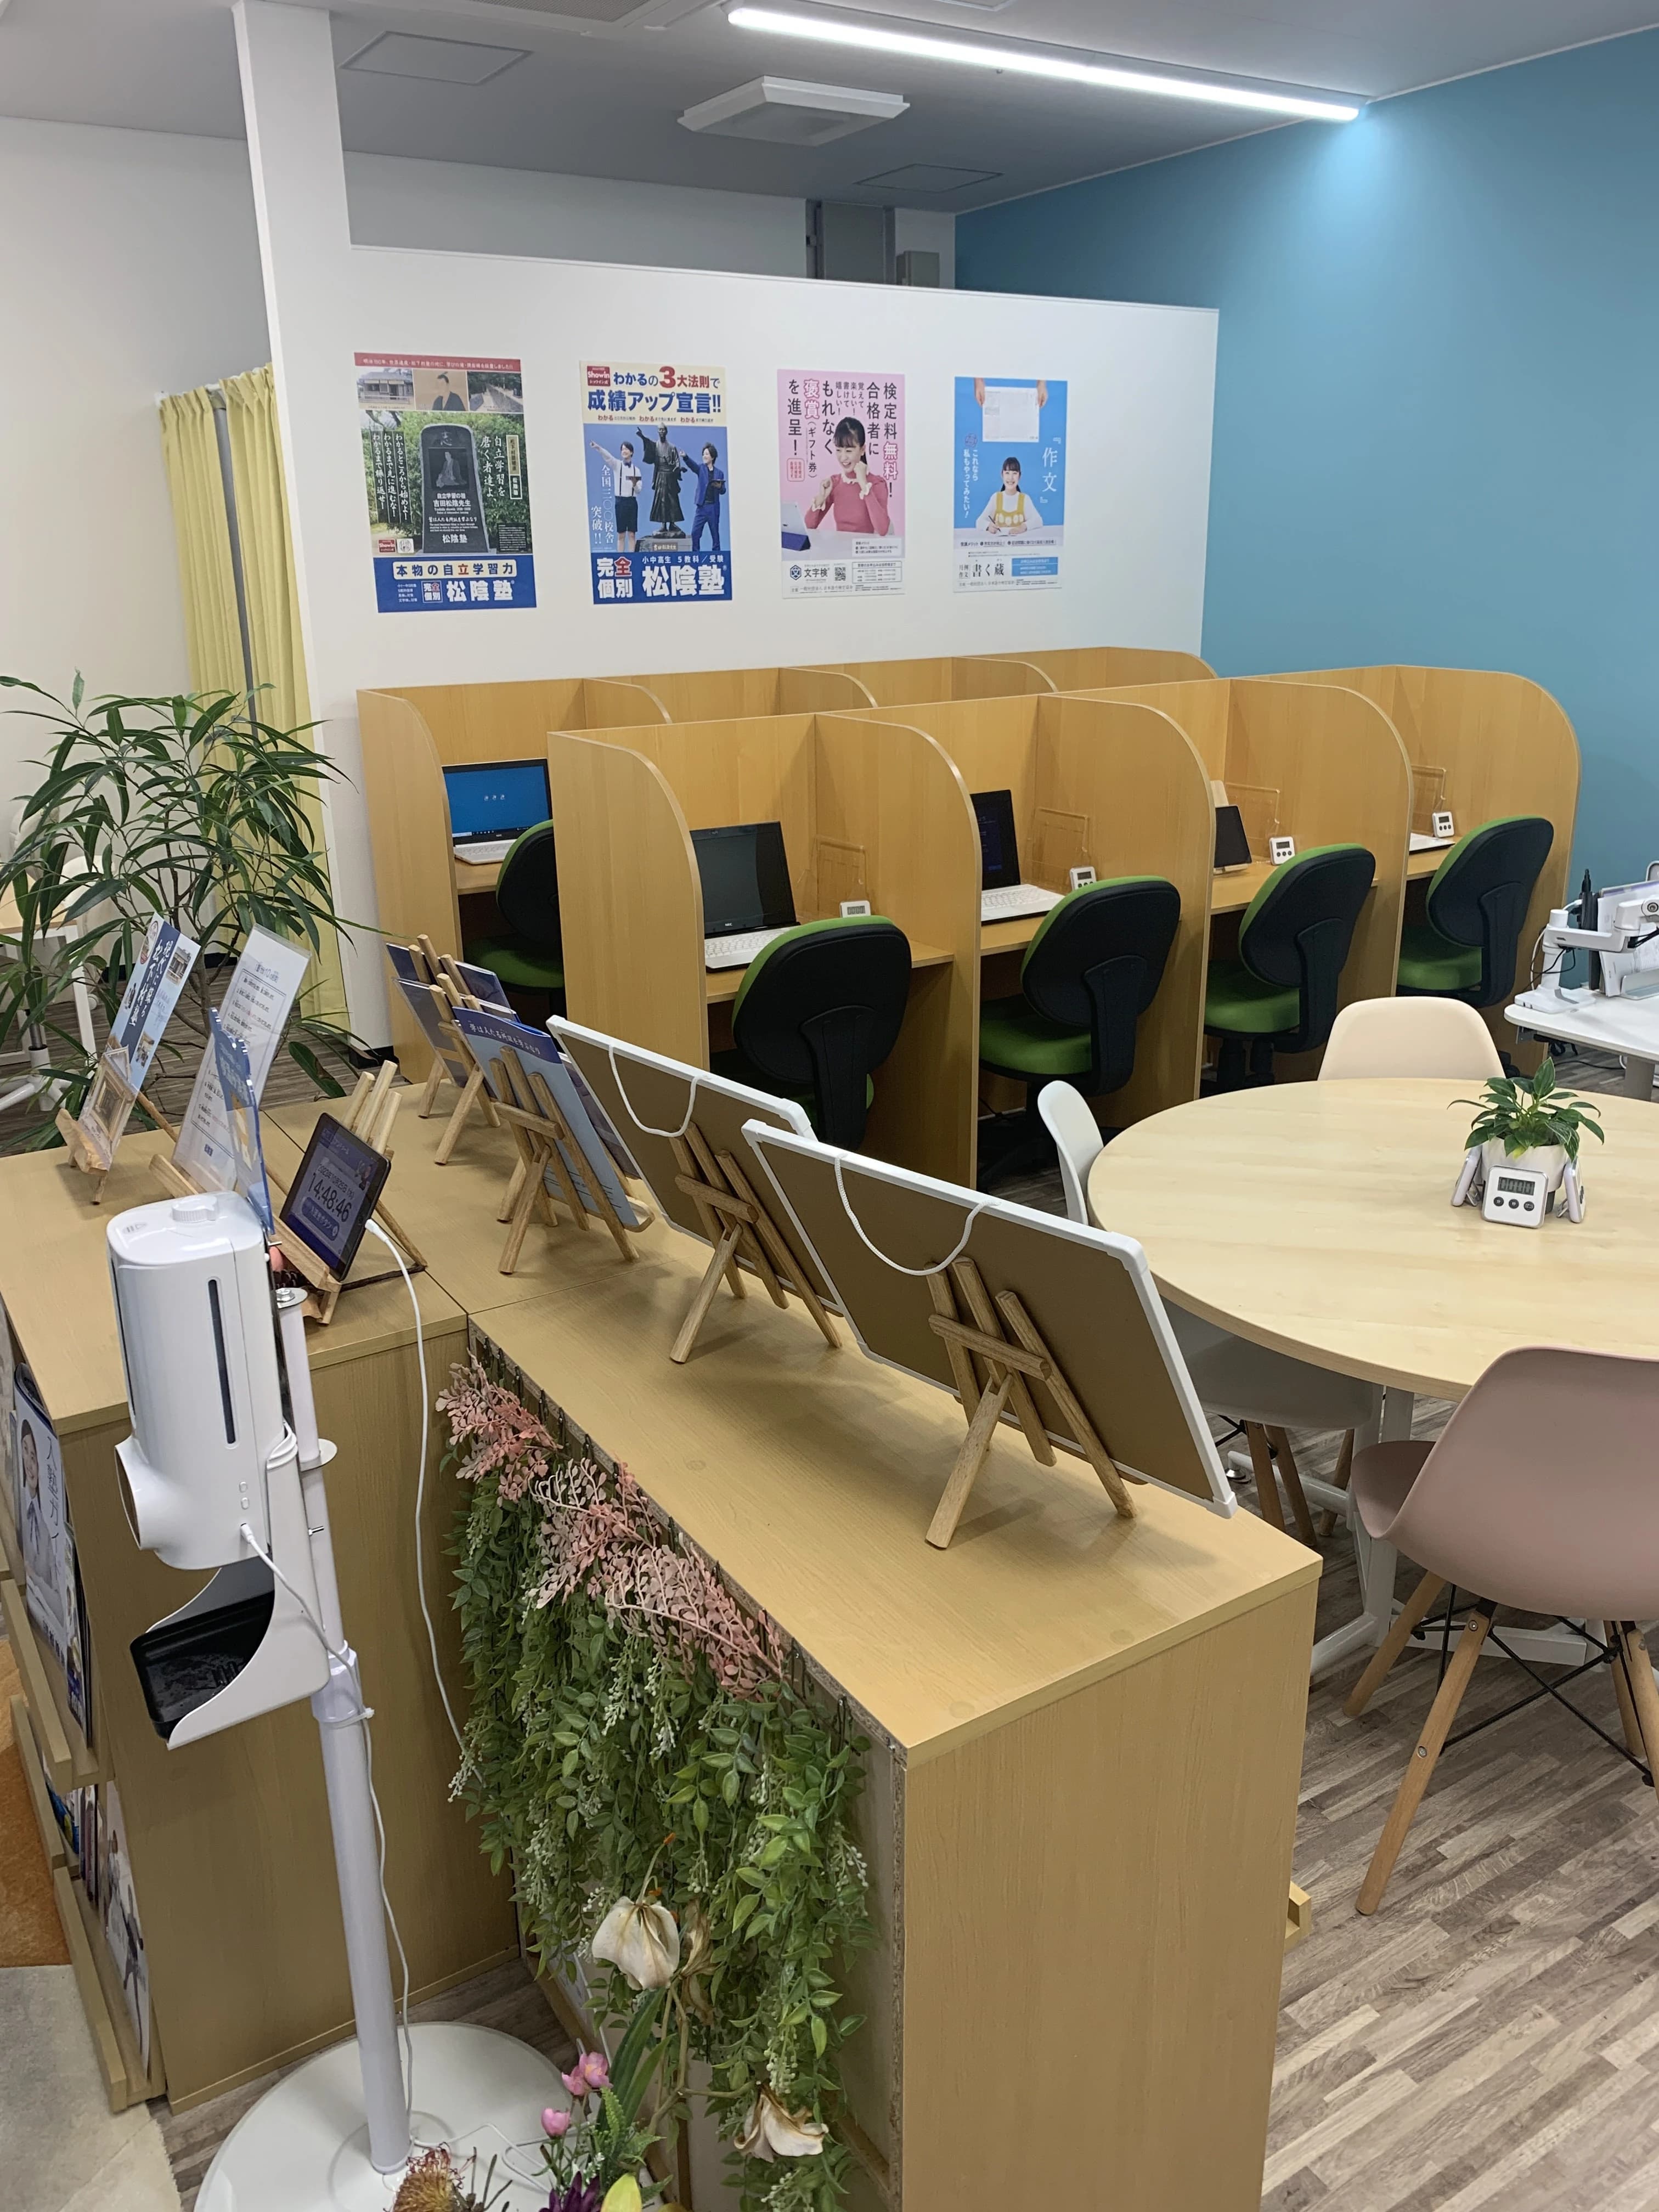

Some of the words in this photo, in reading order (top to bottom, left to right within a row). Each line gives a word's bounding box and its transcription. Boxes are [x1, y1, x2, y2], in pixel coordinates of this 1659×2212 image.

[613, 366, 720, 389] わかるの3大法則で
[588, 390, 721, 414] 成績アップ宣言!!
[787, 379, 802, 455] を進呈！
[822, 380, 836, 455] もれなく
[866, 382, 881, 455] 合格者に
[440, 431, 453, 447] 志
[883, 382, 898, 498] 検定料無料！
[494, 435, 505, 496] 自立学習を
[442, 534, 468, 543] 松陰塾
[396, 563, 514, 577] 本物の自立学習力
[596, 556, 632, 577] 完全
[642, 556, 672, 564] 小中高生
[973, 563, 1005, 577] 書く蔵
[642, 565, 725, 597] 松陰塾
[804, 568, 828, 578] 文字検
[423, 582, 440, 592] 完全
[446, 580, 514, 602] 松陰塾
[597, 579, 633, 599] 個別
[308, 1172, 352, 1222] 14:48:46
